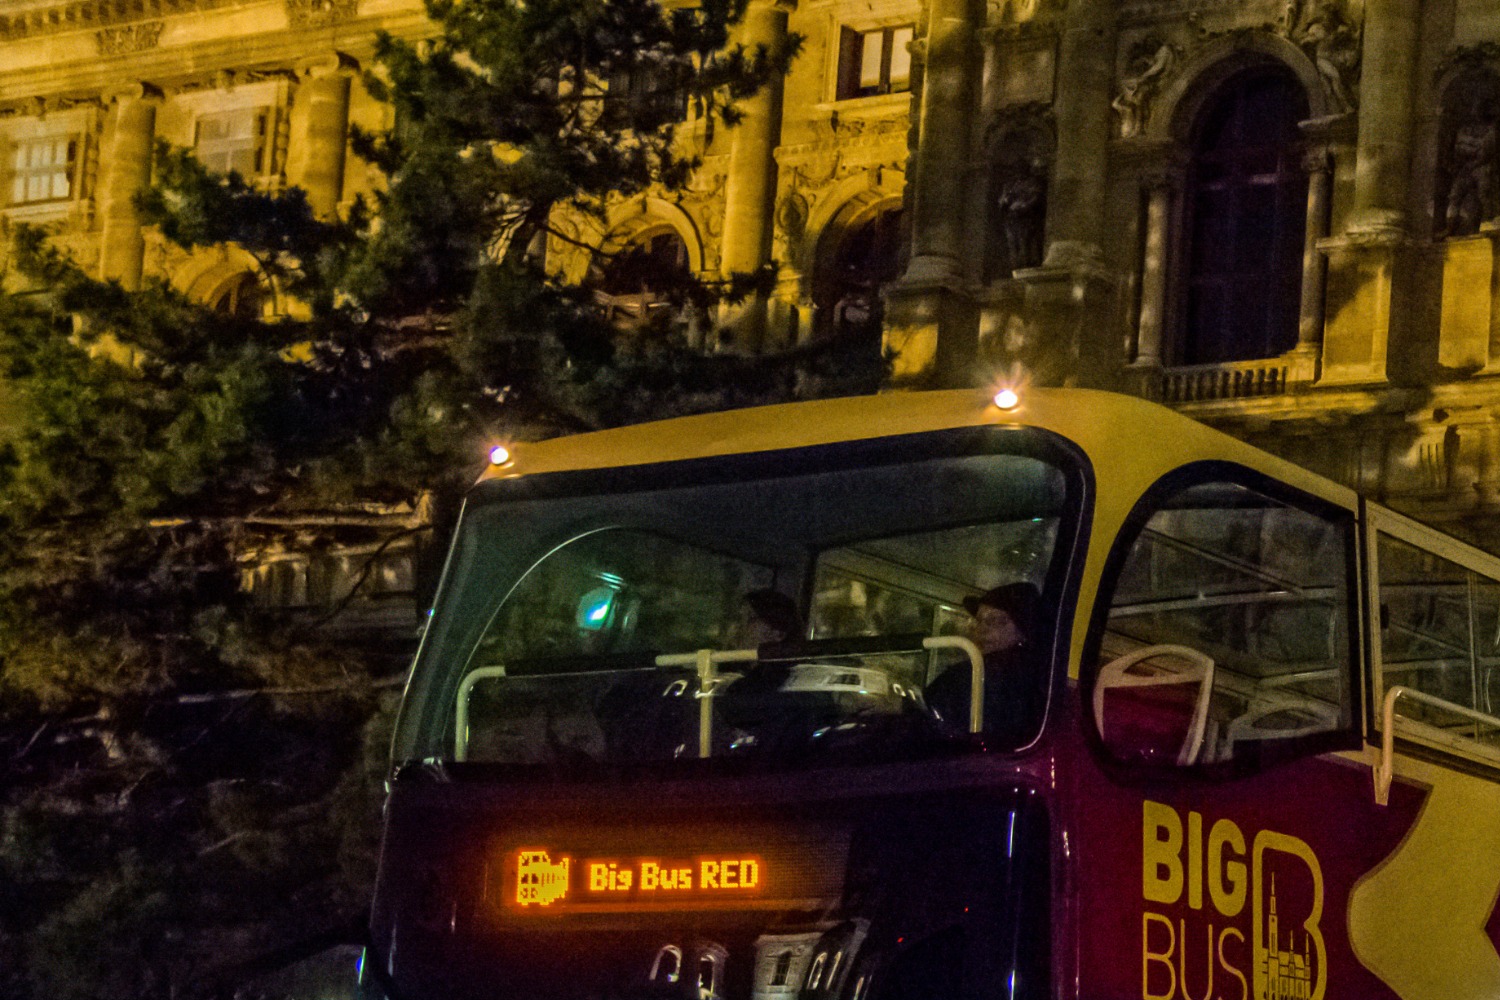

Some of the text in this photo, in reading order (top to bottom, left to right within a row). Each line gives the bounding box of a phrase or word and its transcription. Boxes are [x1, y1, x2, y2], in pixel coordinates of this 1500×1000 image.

[590, 860, 758, 891] Big Bus RED
[1143, 800, 1248, 917] BIG
